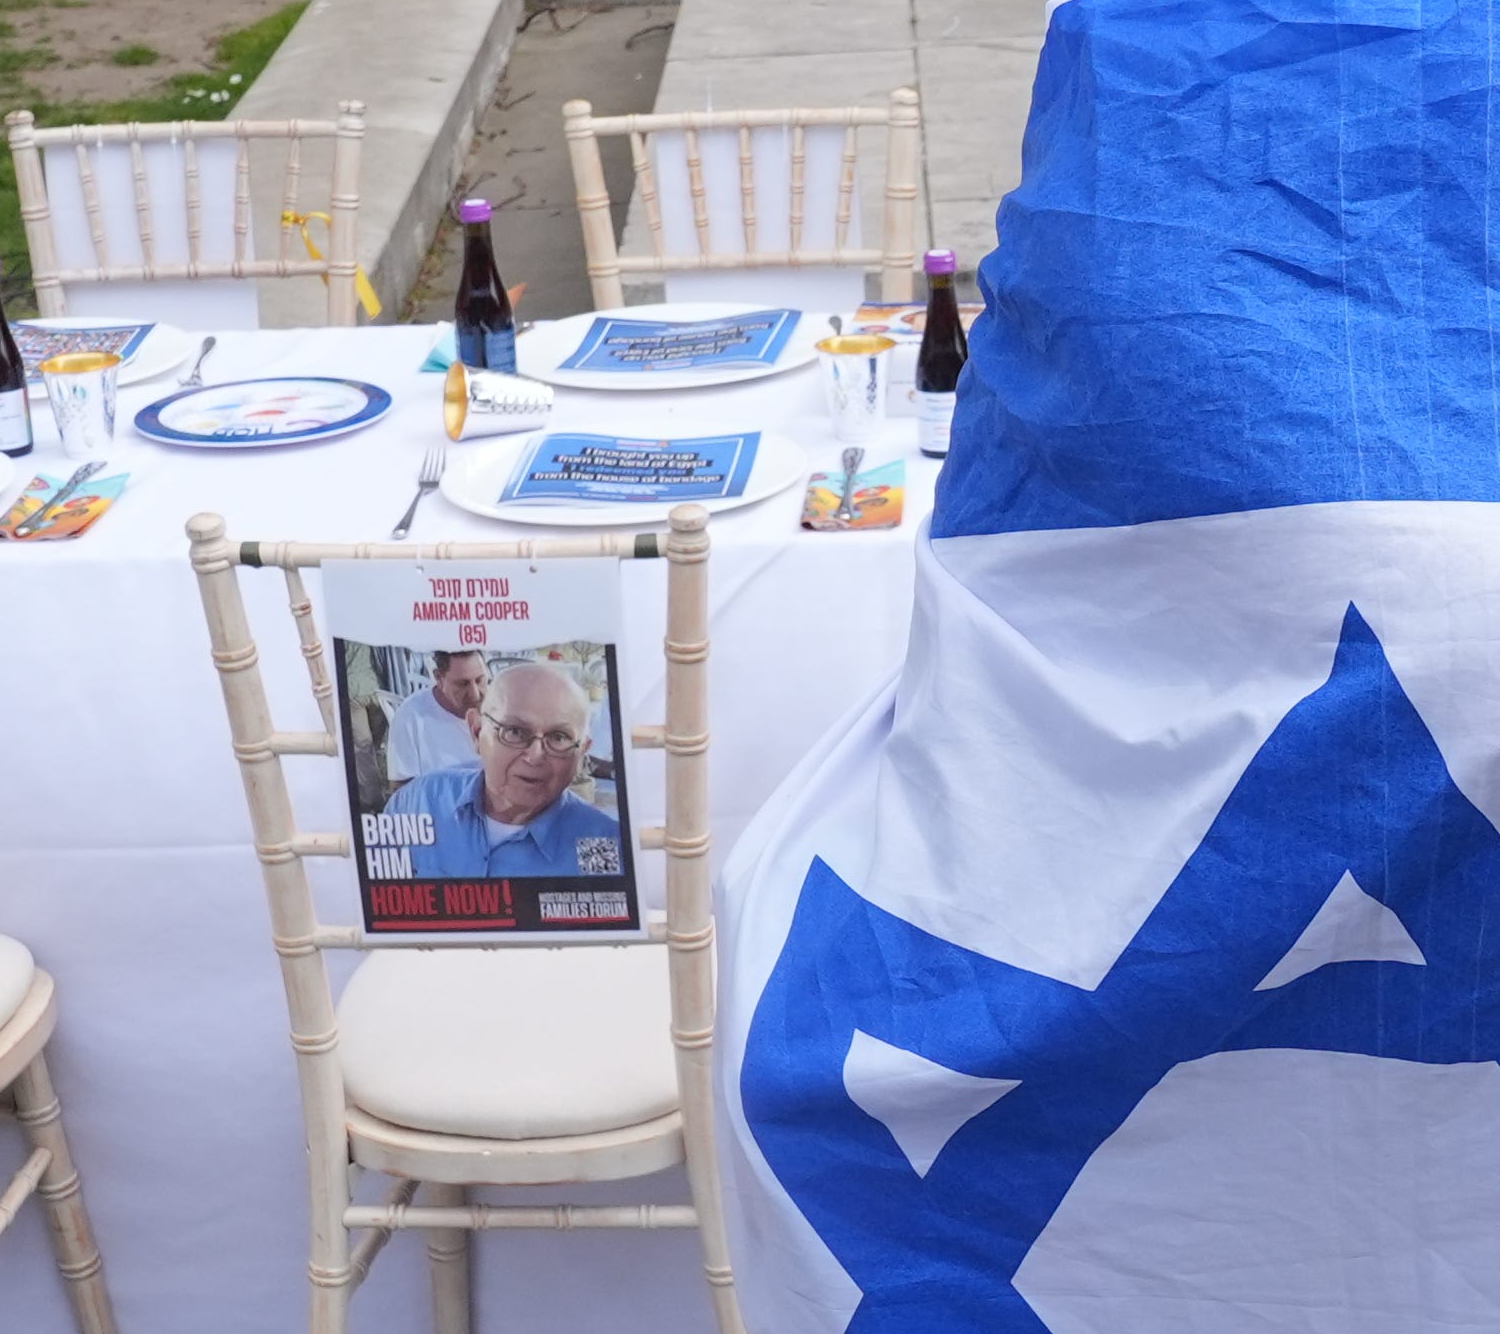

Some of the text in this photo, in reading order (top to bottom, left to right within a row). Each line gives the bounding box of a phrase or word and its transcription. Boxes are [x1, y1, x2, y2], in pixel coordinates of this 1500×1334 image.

[428, 577, 509, 601] עמירם קופר
[413, 600, 530, 621] AMIRAM COOPER
[458, 623, 487, 646] (85)
[361, 813, 436, 846] BRING
[366, 847, 413, 879] HIM
[370, 884, 438, 916] HOME
[540, 902, 628, 919] FAMILIES FORUM
